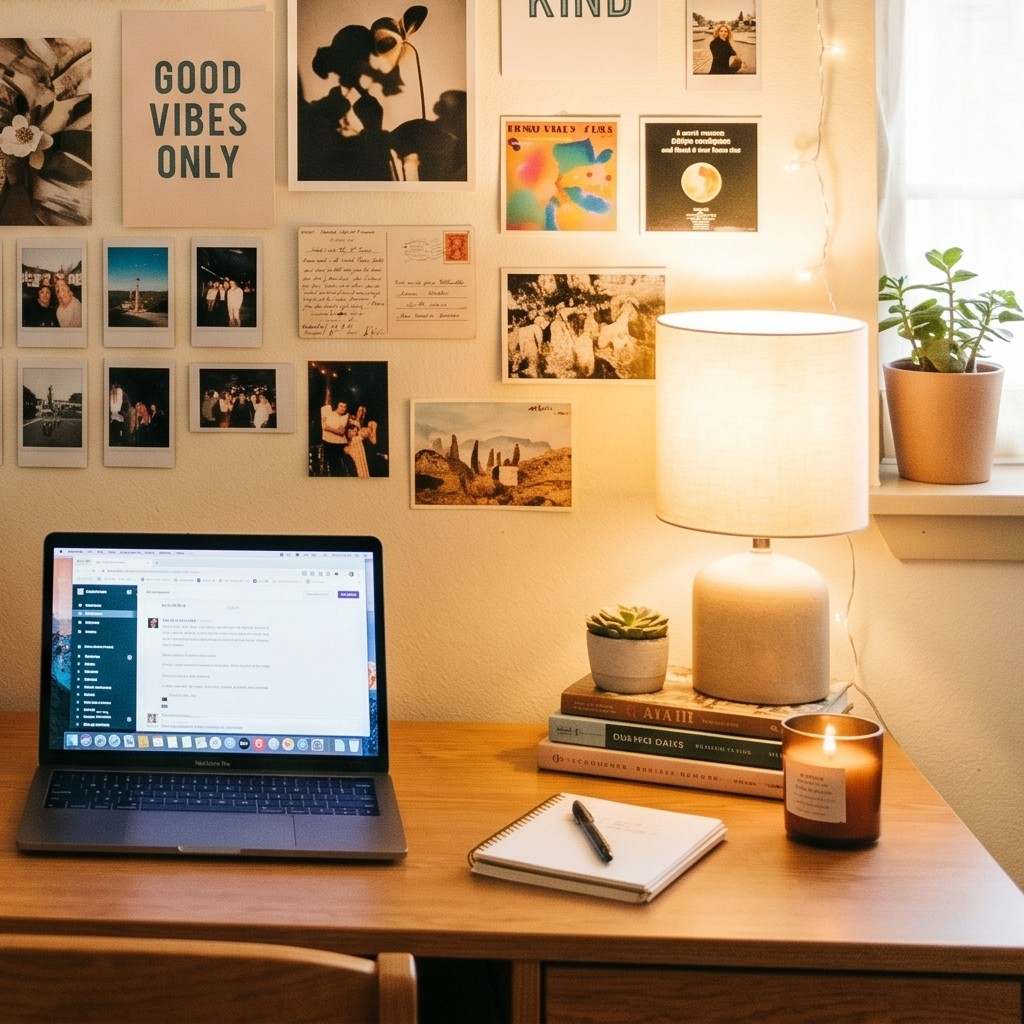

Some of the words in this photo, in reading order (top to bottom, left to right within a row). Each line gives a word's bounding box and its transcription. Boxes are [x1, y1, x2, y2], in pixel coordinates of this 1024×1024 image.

[154, 60, 241, 95] GOOD
[149, 102, 248, 137] VIBES
[157, 144, 240, 179] ONLY
